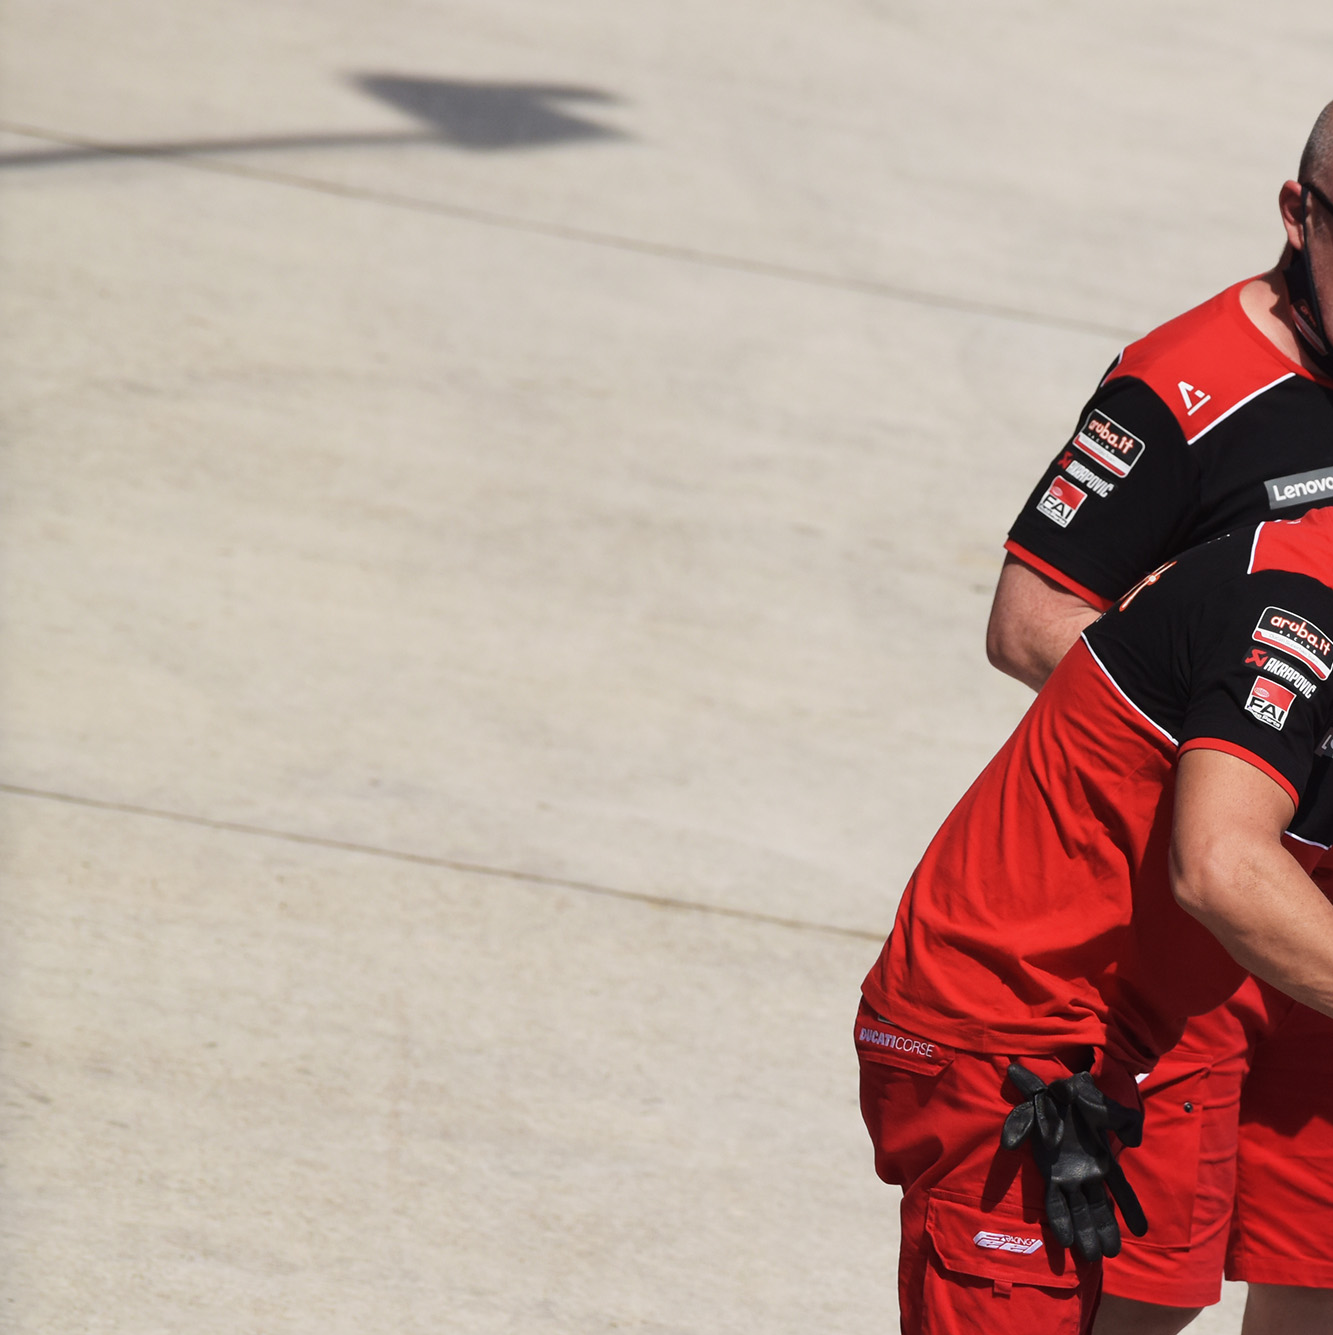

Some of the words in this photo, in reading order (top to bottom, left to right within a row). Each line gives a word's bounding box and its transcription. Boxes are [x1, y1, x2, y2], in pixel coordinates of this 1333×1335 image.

[1088, 419, 1134, 454] aruba.it
[1042, 494, 1073, 519] FAI
[1270, 615, 1331, 656] aruba.it
[1263, 657, 1317, 699] AKRAPOVIC
[1249, 696, 1284, 722] FAI
